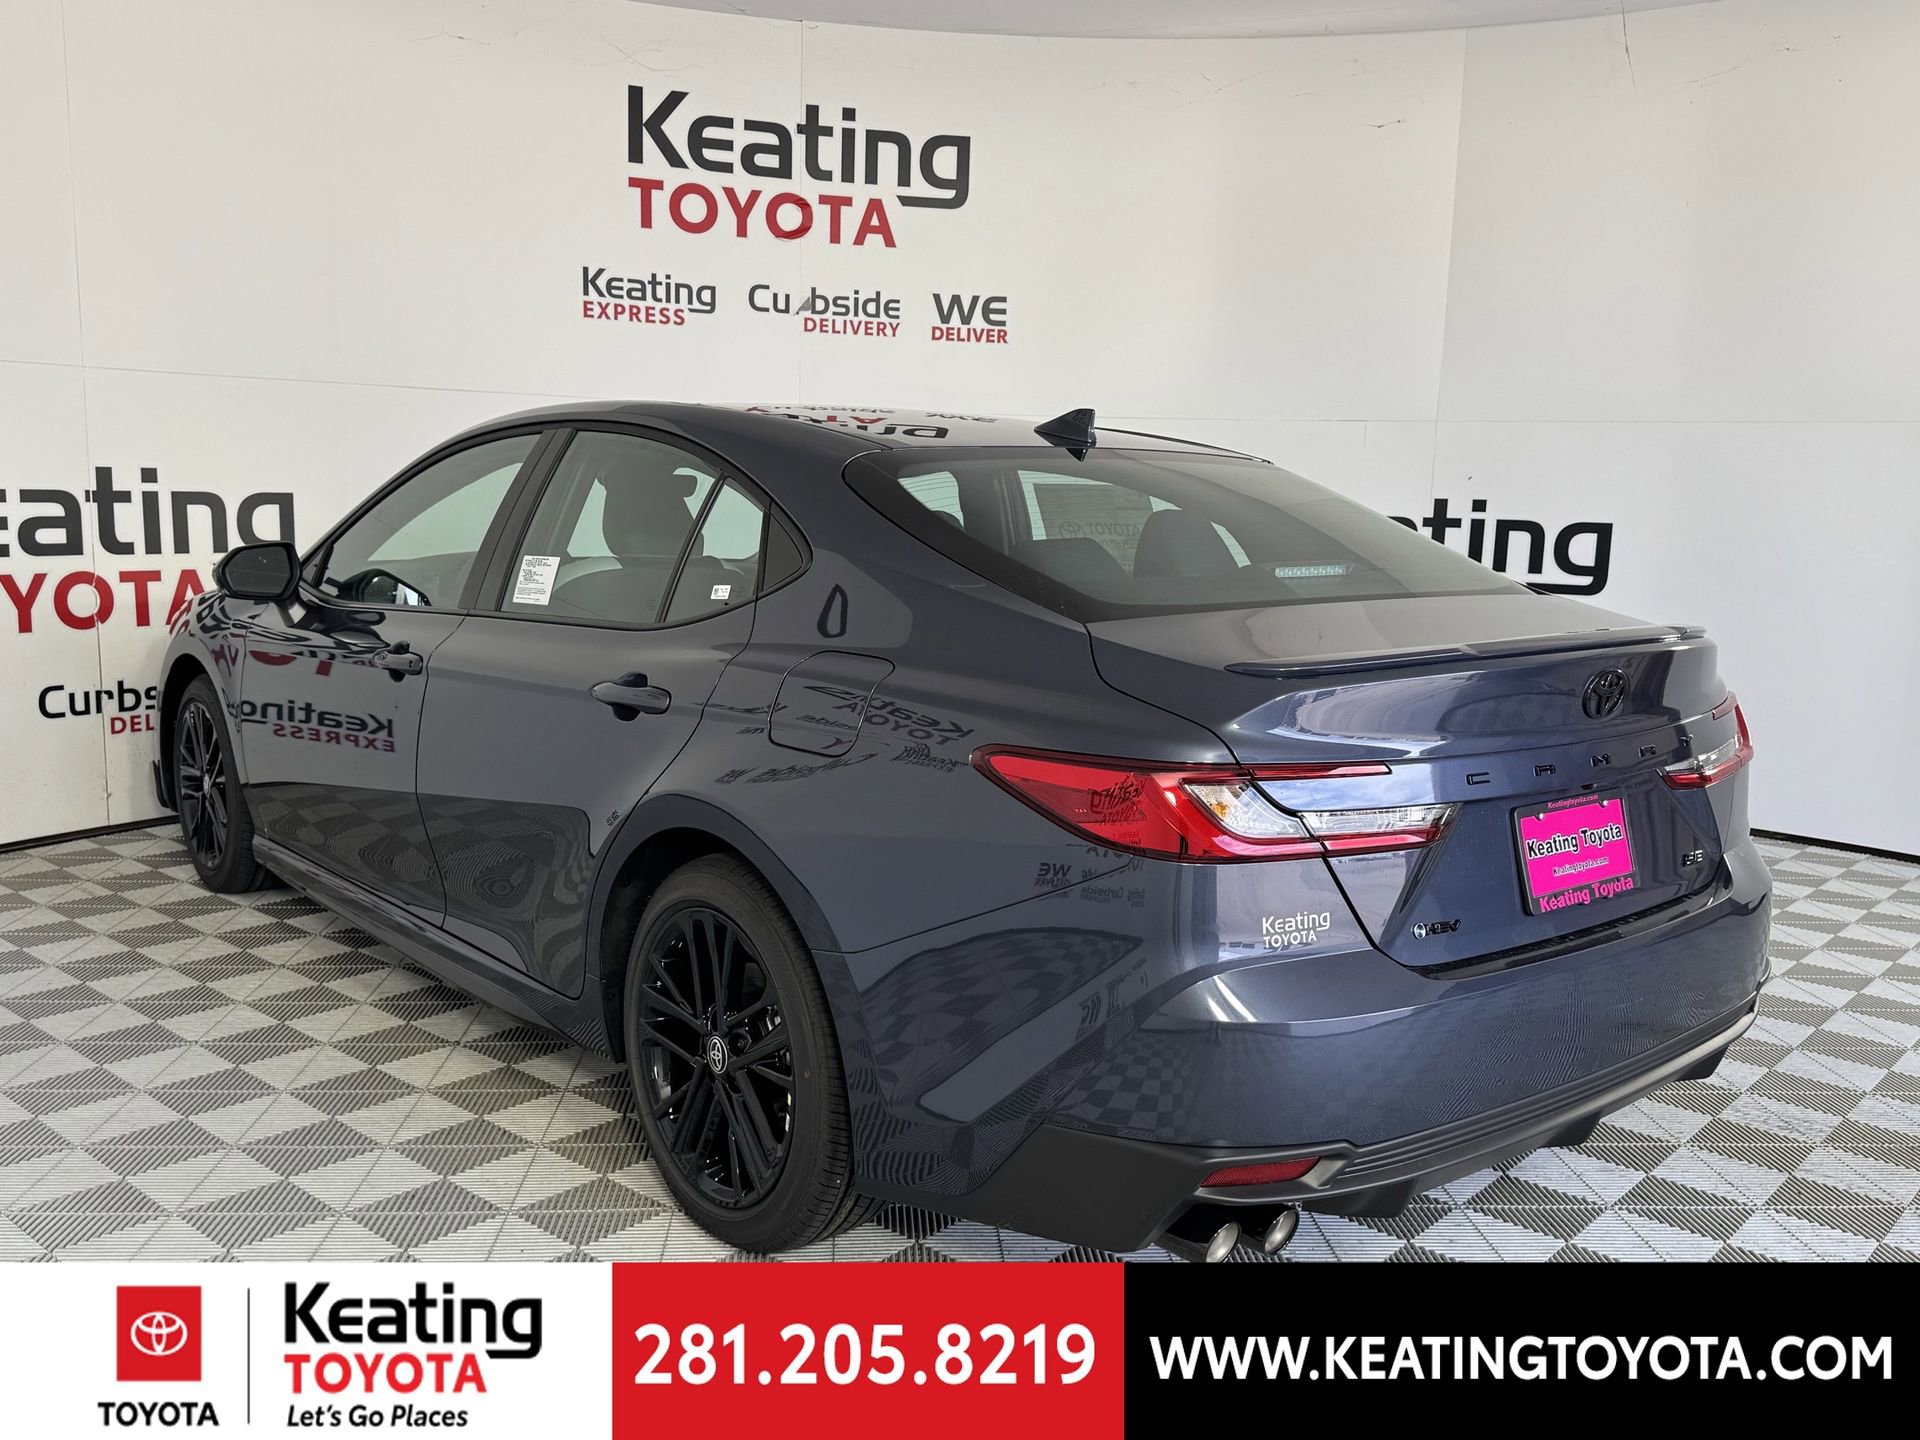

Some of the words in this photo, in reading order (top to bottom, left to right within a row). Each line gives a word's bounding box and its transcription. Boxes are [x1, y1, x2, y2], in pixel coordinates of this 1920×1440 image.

[627, 85, 971, 209] Keating
[627, 176, 897, 248] TOYOTA
[582, 266, 716, 314] Keating
[748, 284, 900, 320] Cubside
[582, 301, 686, 326] EXPRESS
[803, 317, 900, 338] DELIVERY
[932, 293, 1007, 327] WE
[930, 326, 1008, 344] DELIVER
[0, 466, 296, 558] ating
[1526, 833, 1579, 859] Keating
[1580, 823, 1623, 848] Toyota
[1539, 888, 1591, 912] Keating
[1591, 876, 1634, 898] Toyota
[1262, 911, 1331, 934] Keating
[1263, 931, 1317, 949] TOYOTA
